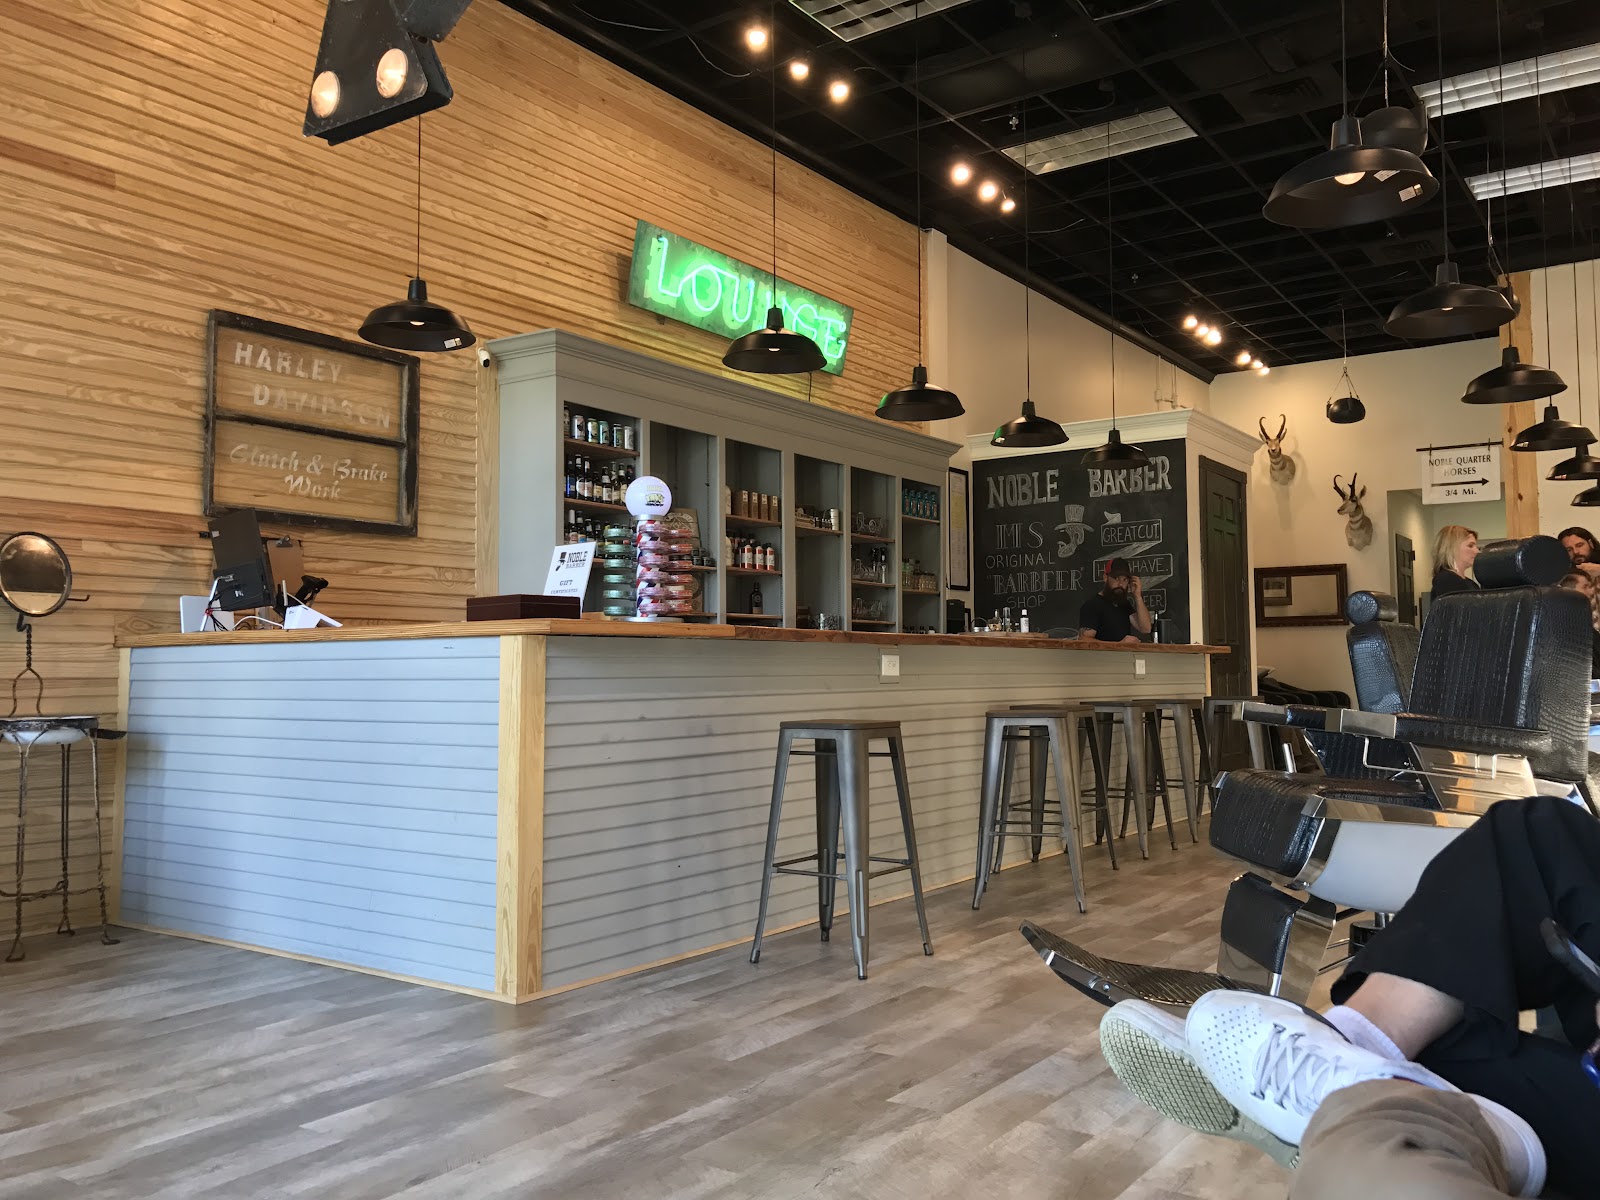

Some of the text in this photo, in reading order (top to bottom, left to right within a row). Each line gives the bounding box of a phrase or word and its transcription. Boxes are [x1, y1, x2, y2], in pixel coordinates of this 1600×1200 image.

[234, 341, 343, 384] HARLEY
[230, 443, 389, 482] Clutch & Brake
[1428, 454, 1492, 467] NOBLE QUARTER
[1443, 466, 1477, 477] HORSES
[284, 474, 341, 499] Work
[986, 455, 1173, 509] NOBLE BARBER
[1445, 487, 1477, 497] 3/4 Mi.
[567, 551, 588, 563] NOBLE
[985, 551, 1056, 569] ORIGINAL
[1006, 594, 1047, 609] SHOP
